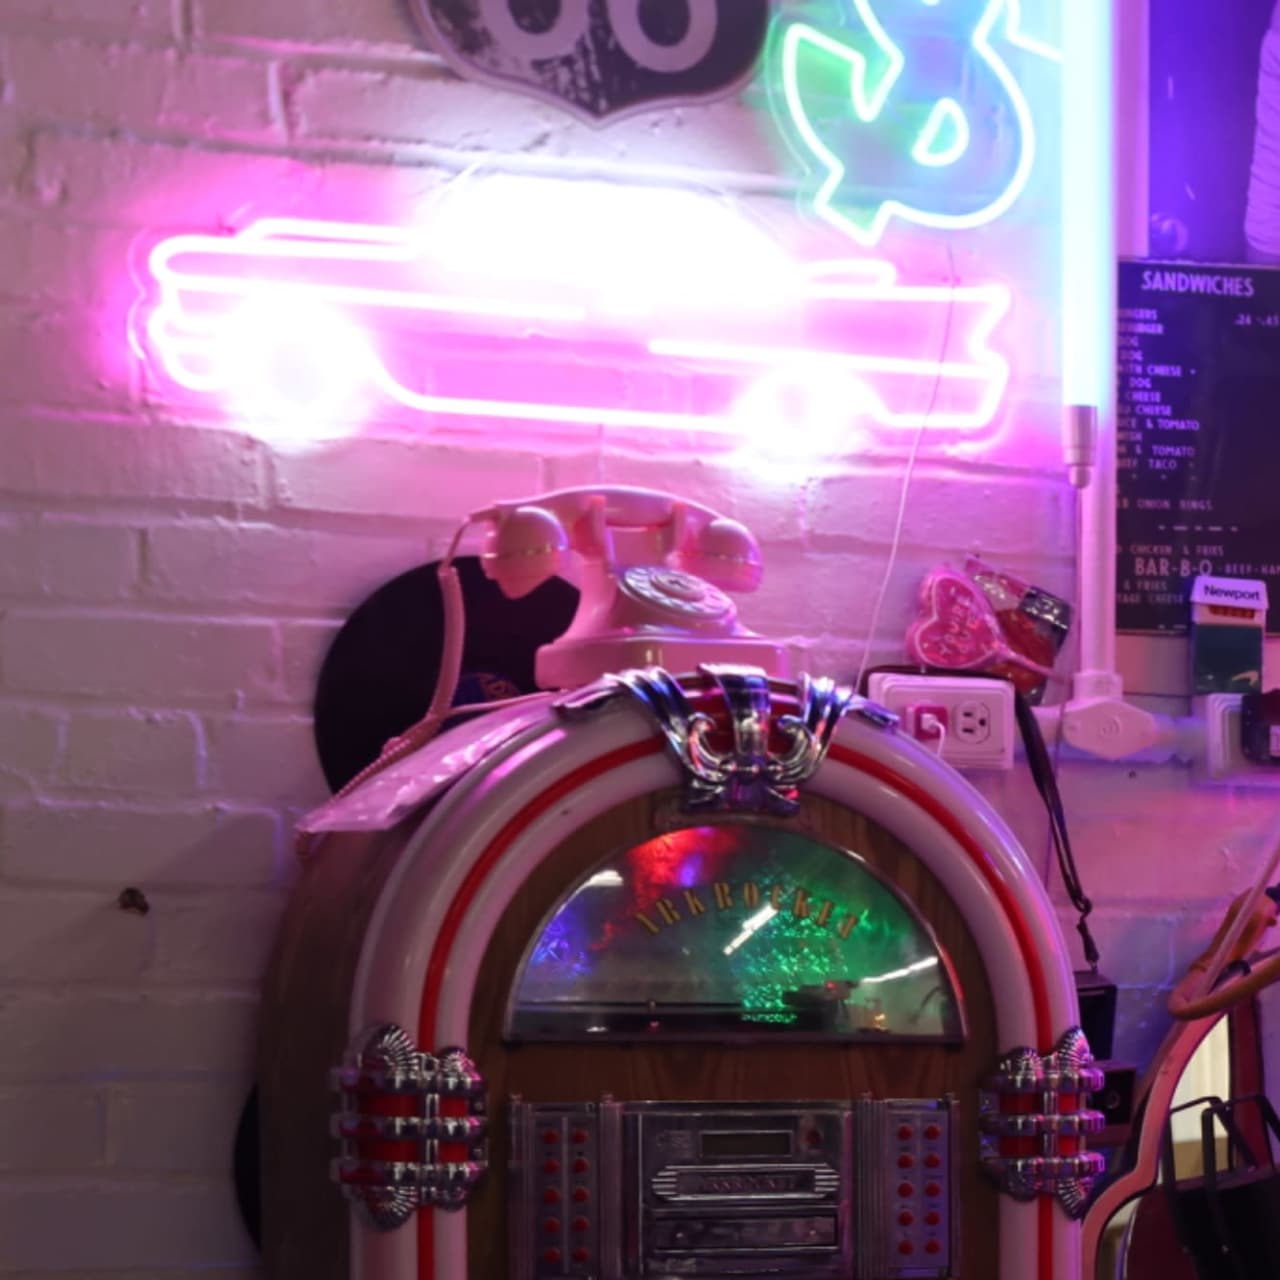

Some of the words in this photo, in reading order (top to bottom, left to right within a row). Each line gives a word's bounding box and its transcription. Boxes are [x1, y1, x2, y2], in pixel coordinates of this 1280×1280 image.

[1140, 269, 1255, 297] SANDWICHES
[1148, 458, 1178, 470] TACO
[1203, 584, 1260, 601] Newport
